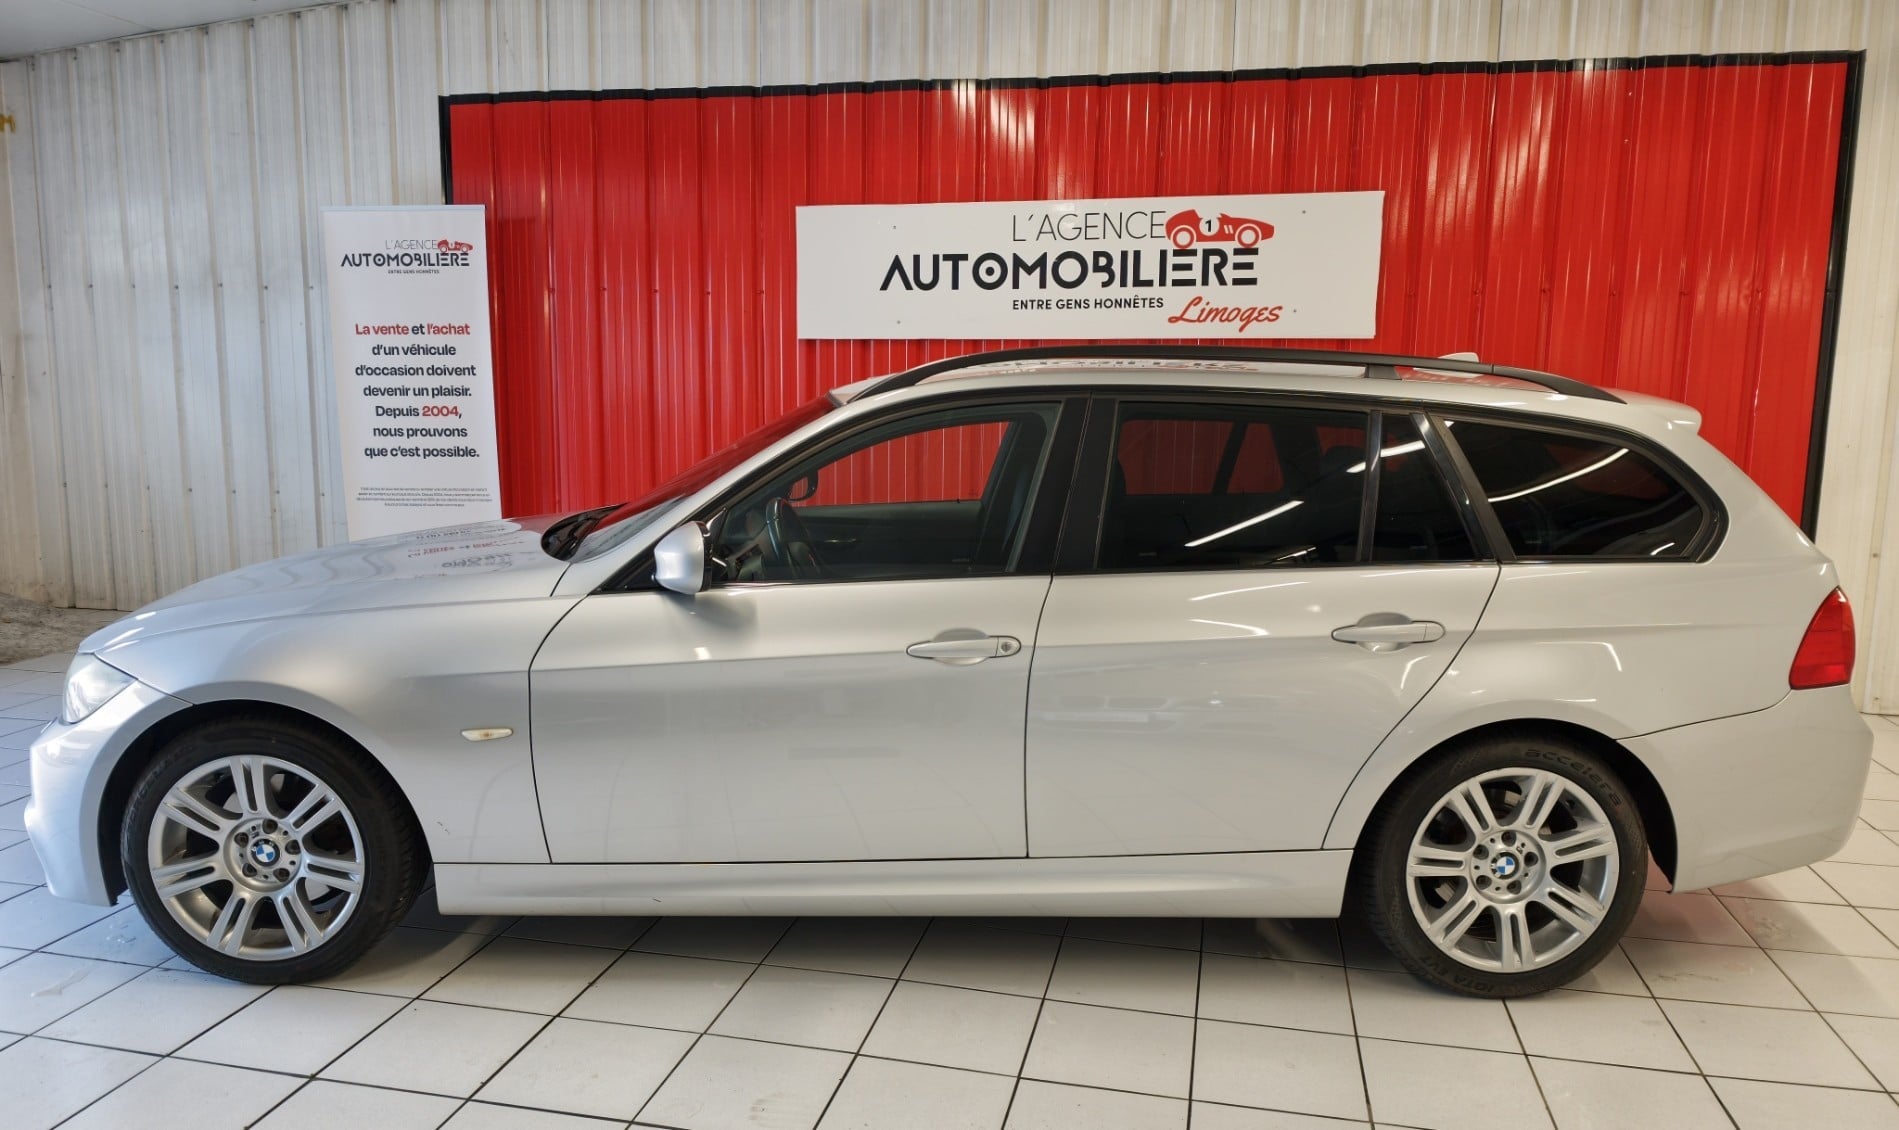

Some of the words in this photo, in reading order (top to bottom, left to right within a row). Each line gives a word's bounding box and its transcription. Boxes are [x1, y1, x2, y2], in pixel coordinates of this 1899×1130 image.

[1012, 211, 1166, 241] L'AGENCE
[1205, 219, 1212, 233] 1
[385, 239, 438, 250] L'AGENCE
[1012, 299, 1052, 310] ENTRE
[1056, 299, 1090, 310] GENS
[1094, 294, 1164, 309] HONNÊTES
[1168, 296, 1283, 333] Limoges
[355, 323, 370, 335] La
[372, 324, 409, 335] vente
[411, 323, 425, 335] et
[427, 323, 470, 335] l'achat
[372, 344, 400, 356] d'un
[401, 343, 456, 356] véhicule
[355, 364, 424, 376] d'occasion
[426, 364, 477, 376] doivent
[363, 385, 411, 397] devenir
[413, 387, 429, 397] un
[431, 385, 472, 398] plaisir.
[375, 405, 419, 419] Depuis
[422, 405, 462, 419] 2004,
[373, 427, 404, 437] nous
[406, 427, 468, 439] prouvons
[364, 447, 388, 459] que
[390, 446, 420, 457] c'est
[422, 446, 480, 459] possible.
